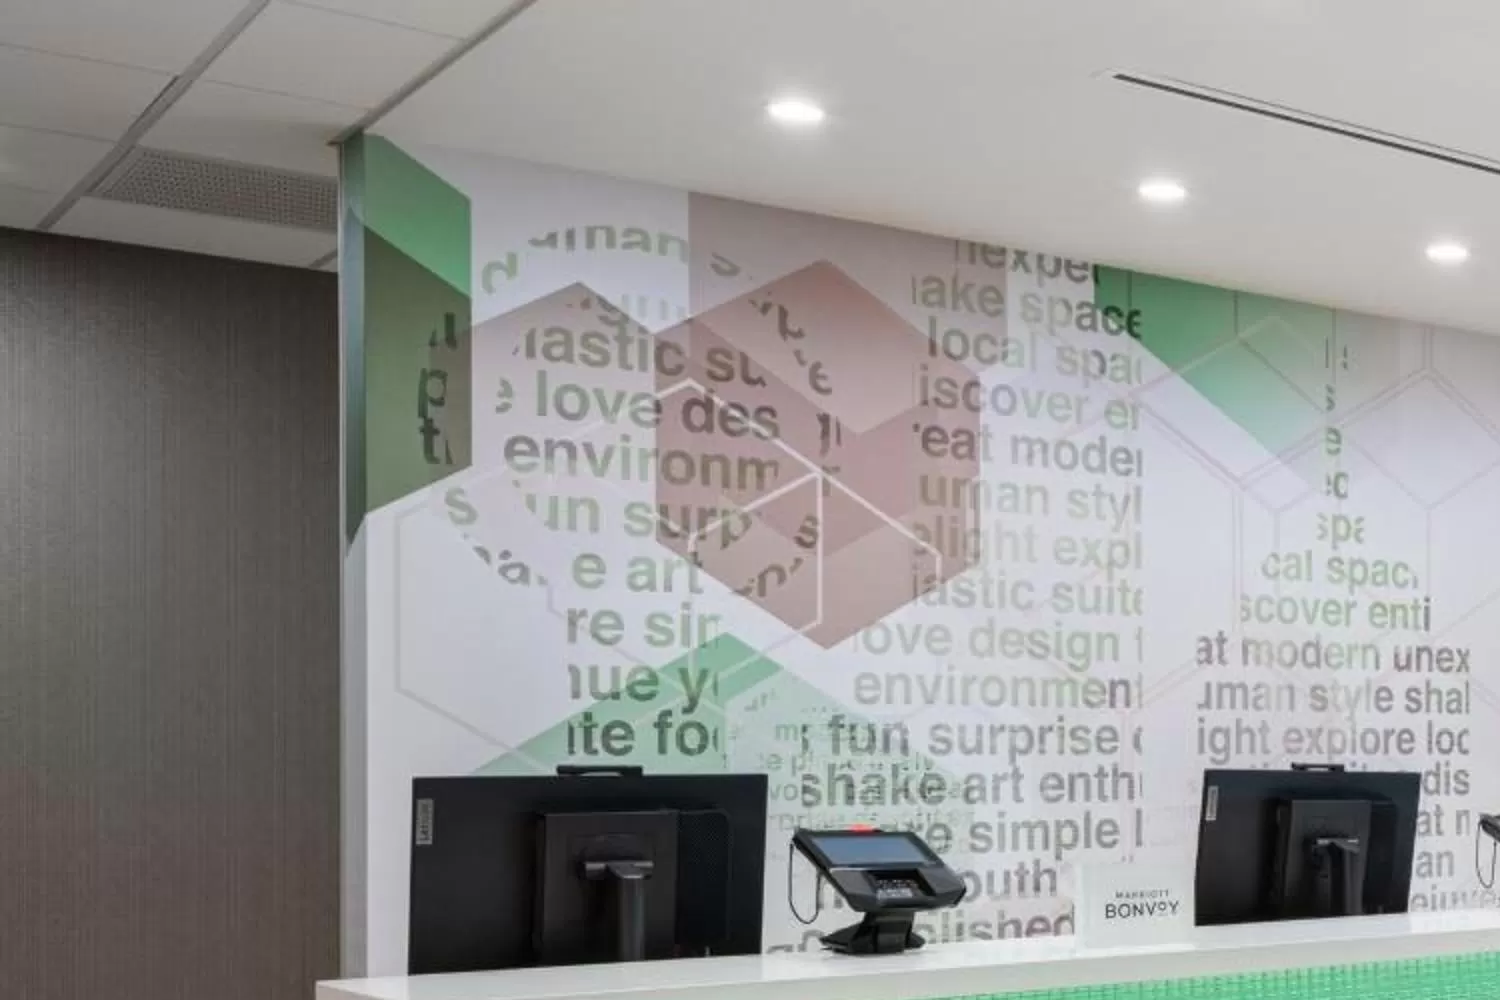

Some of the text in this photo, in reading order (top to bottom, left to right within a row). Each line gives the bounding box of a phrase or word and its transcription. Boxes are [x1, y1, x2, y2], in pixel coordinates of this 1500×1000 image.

[928, 315, 1038, 373] local
[536, 369, 663, 429] love
[626, 551, 704, 595] art
[968, 616, 1121, 673] design
[1241, 634, 1381, 672] modern
[1392, 642, 1471, 675] unex
[1308, 679, 1395, 724] style
[927, 714, 1121, 776] surprise
[1196, 716, 1272, 766] ight
[1281, 717, 1416, 763] explore
[800, 763, 949, 809] shake
[962, 767, 1025, 804] art
[1423, 761, 1471, 797] dis
[968, 808, 1122, 861] simple
